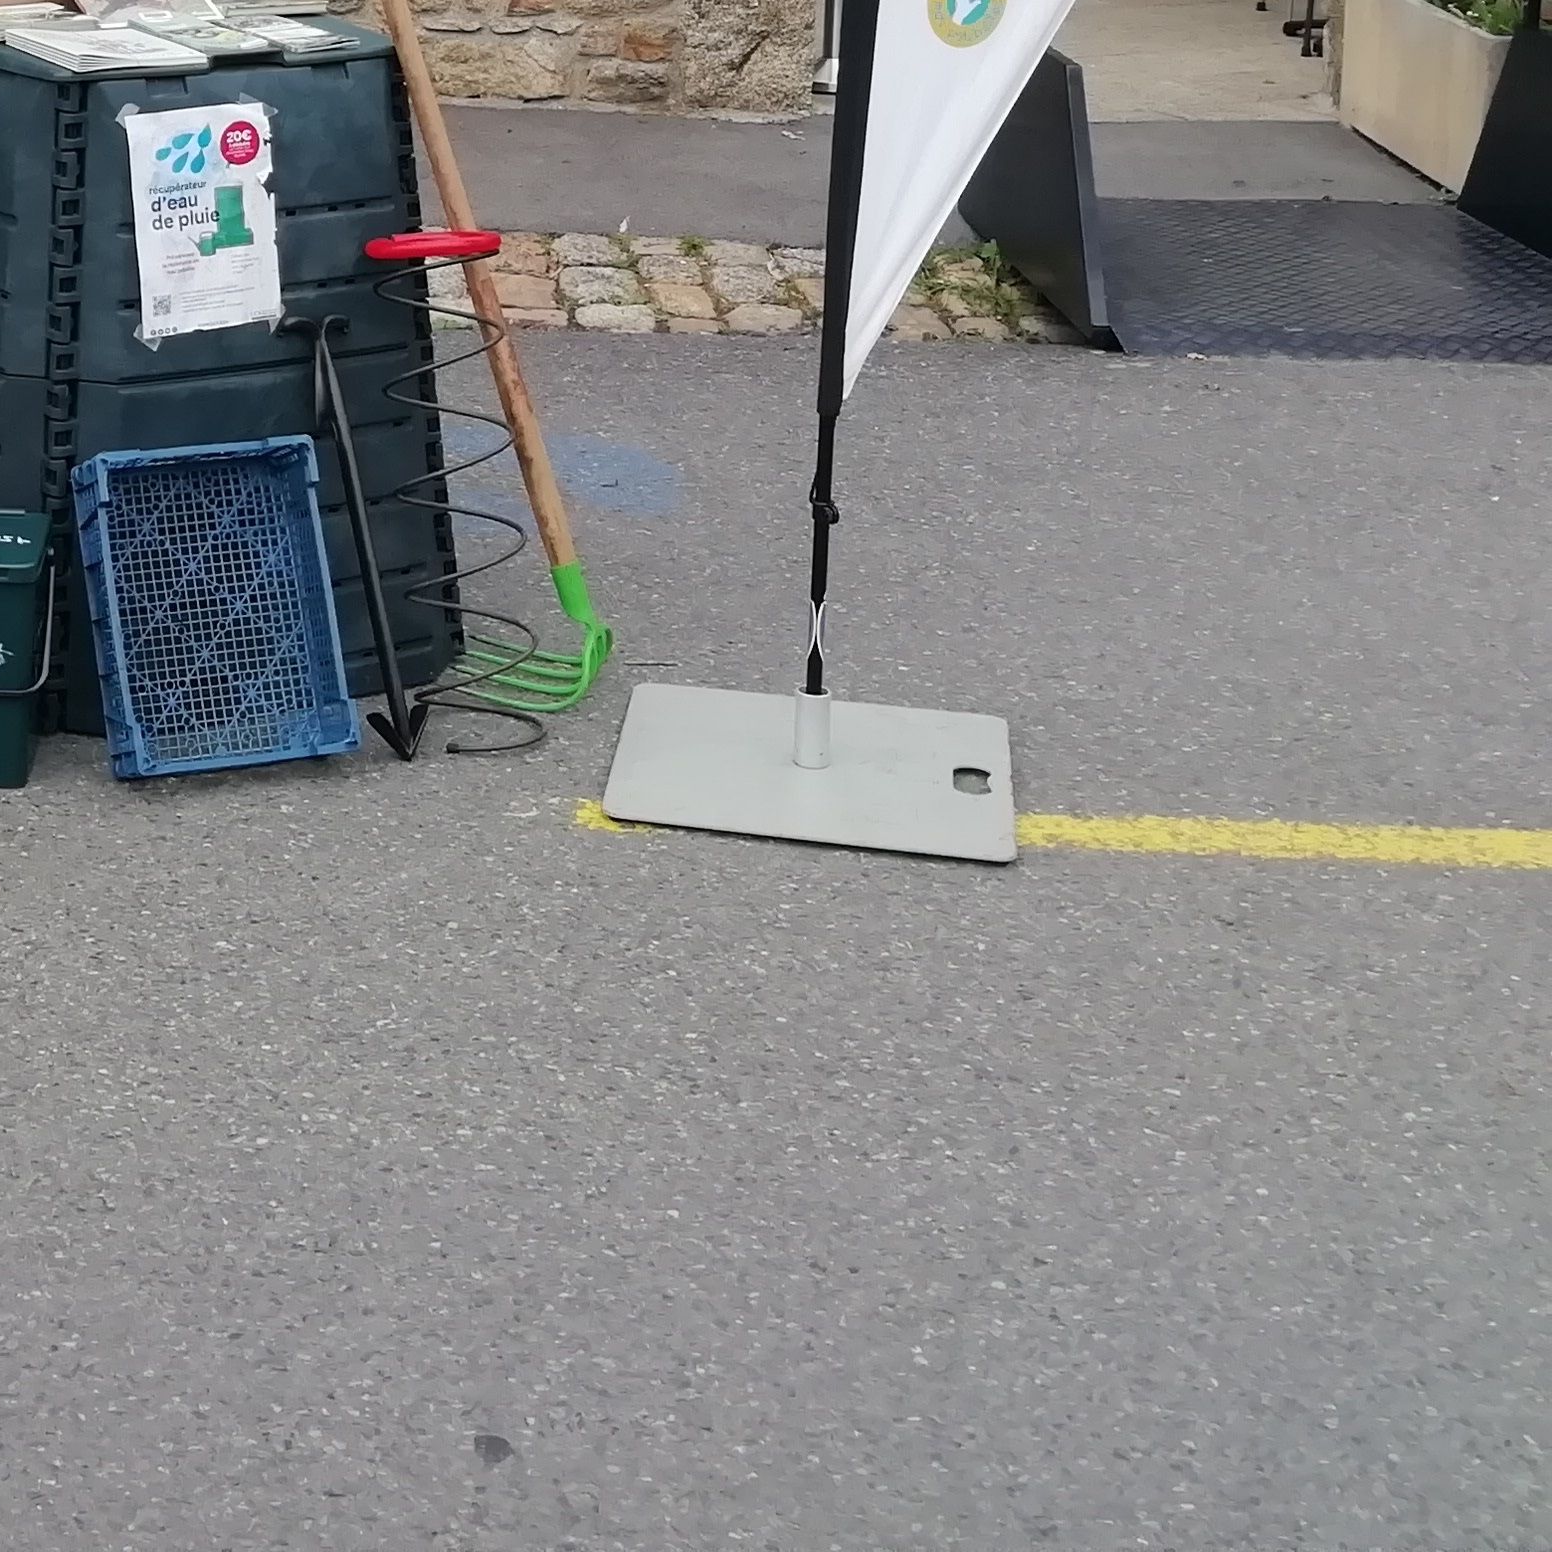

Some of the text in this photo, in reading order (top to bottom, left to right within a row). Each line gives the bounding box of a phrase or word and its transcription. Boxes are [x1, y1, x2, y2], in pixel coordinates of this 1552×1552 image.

[149, 181, 207, 195] récupérateur
[151, 195, 198, 212] d'eau
[152, 207, 220, 231] de pluie
